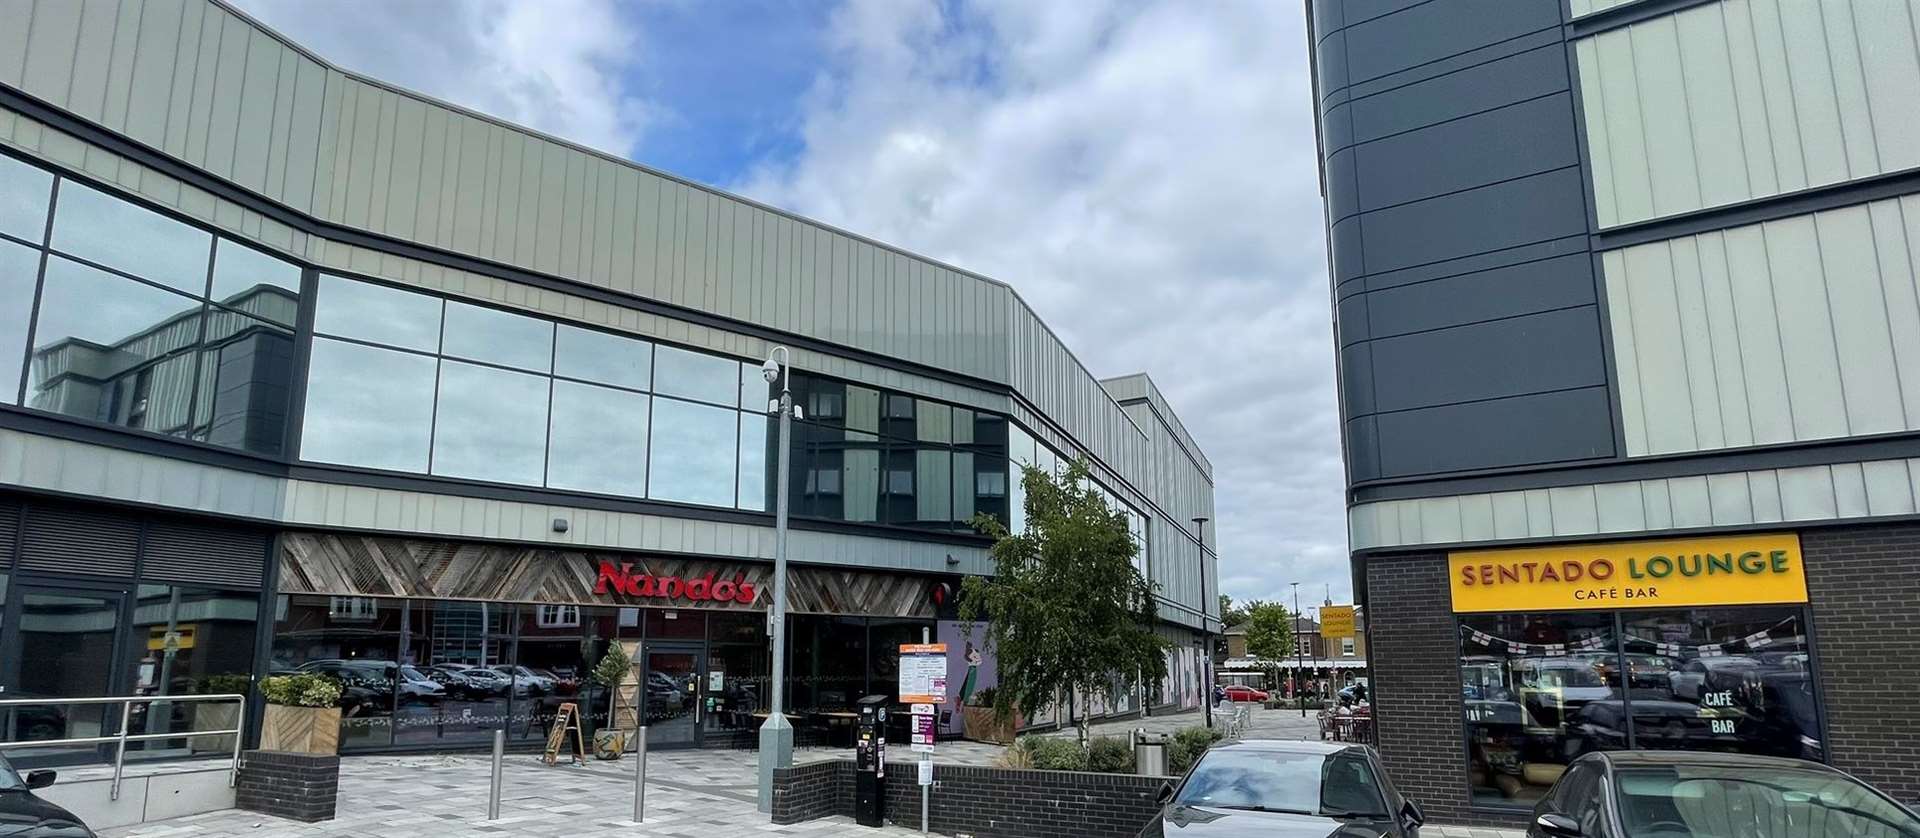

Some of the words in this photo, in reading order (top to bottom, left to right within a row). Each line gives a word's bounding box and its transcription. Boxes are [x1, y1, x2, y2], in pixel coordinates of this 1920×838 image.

[1462, 559, 1615, 587] SENTADO
[1628, 550, 1790, 580] LOUNGE
[593, 560, 755, 603] Nando's
[1574, 586, 1618, 601] CAFÉ
[1625, 587, 1659, 599] BAR
[1705, 689, 1734, 706] CAFÉ
[1711, 719, 1736, 734] BAR
